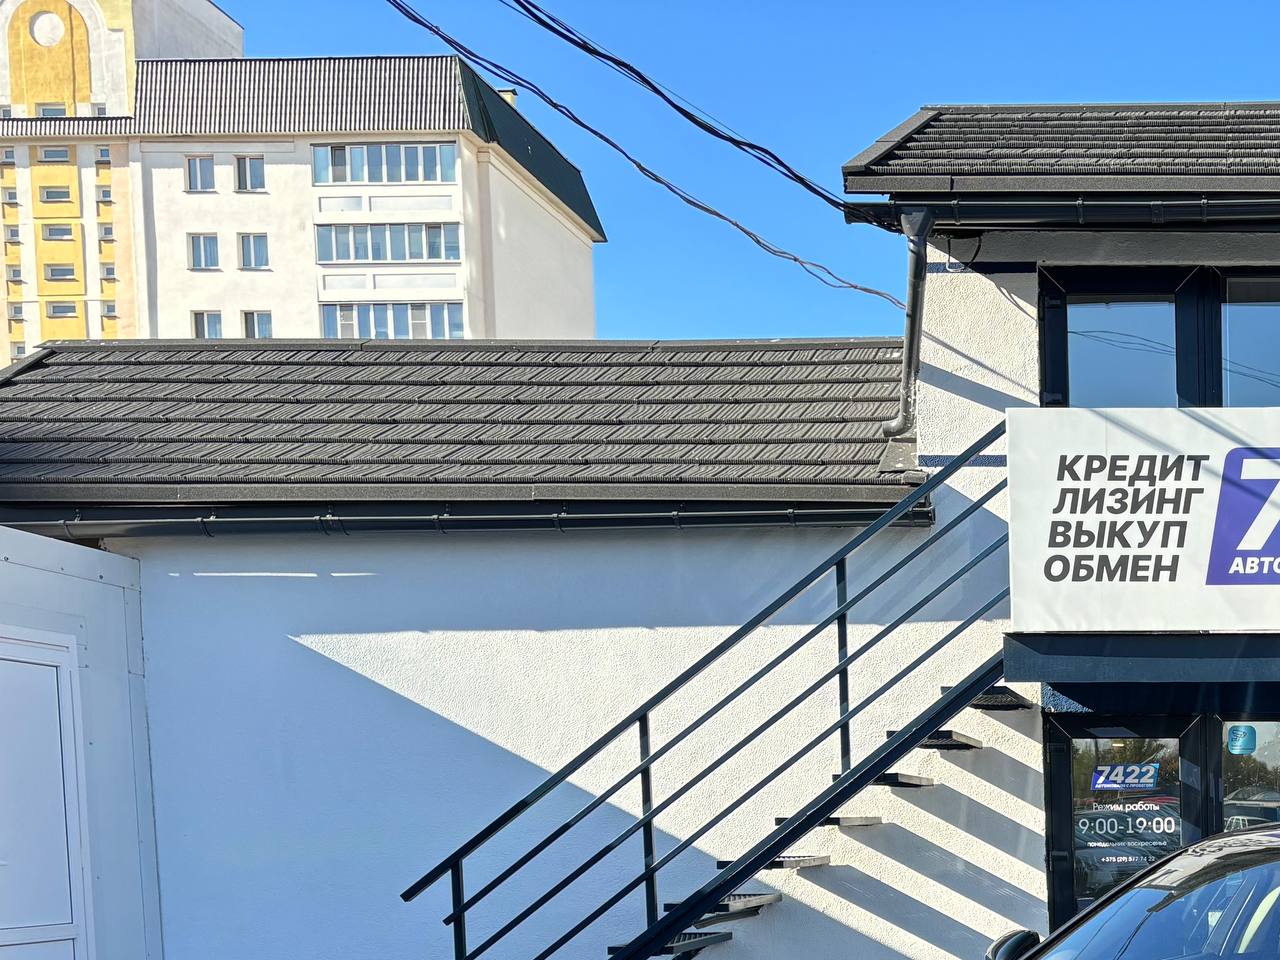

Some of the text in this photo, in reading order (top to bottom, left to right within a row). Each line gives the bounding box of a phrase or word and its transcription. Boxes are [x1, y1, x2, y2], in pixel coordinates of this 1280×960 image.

[1056, 454, 1210, 487] КРЕДИТ
[1052, 487, 1205, 515] ЛИЗИНГ
[1048, 520, 1187, 548] ВЫКУП
[1043, 553, 1178, 583] ОБМЕН
[1096, 765, 1155, 784] 7422
[1092, 801, 1160, 813] Режим работы
[1078, 816, 1176, 834] 9:00-19:00
